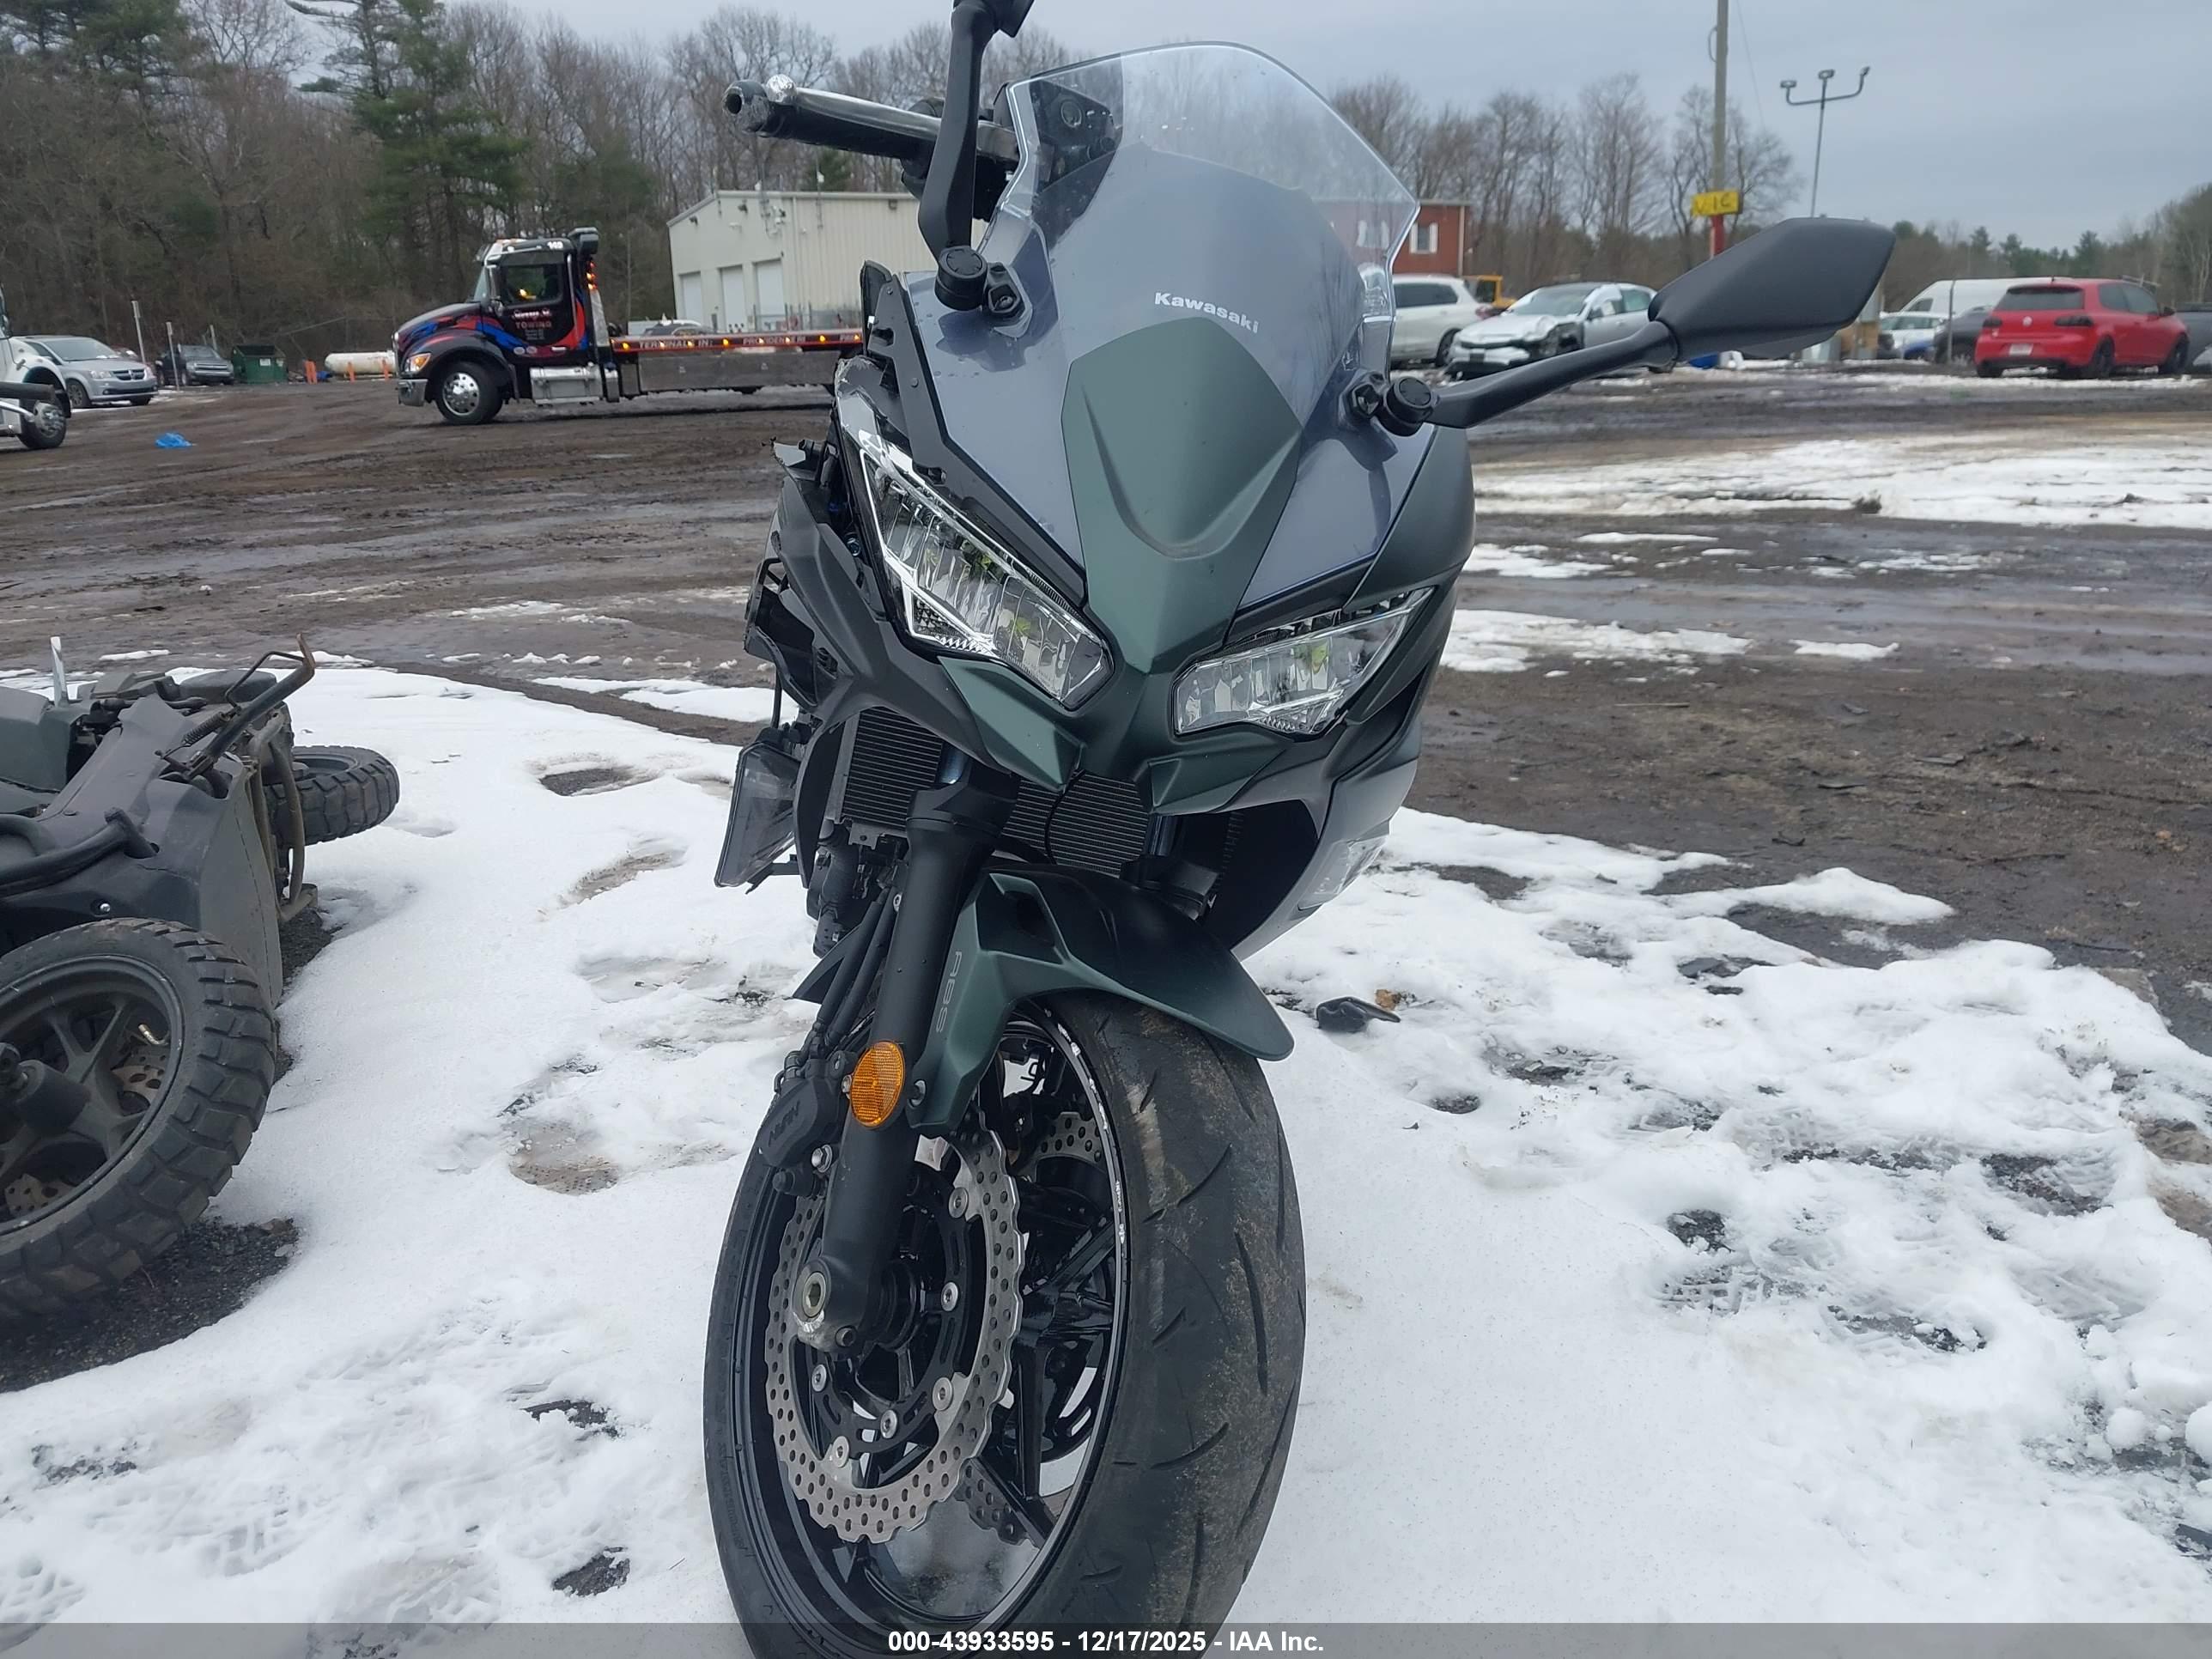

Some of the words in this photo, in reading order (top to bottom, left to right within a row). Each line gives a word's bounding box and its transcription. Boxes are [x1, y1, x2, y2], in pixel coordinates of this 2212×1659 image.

[515, 321, 552, 330] TOWING
[1154, 291, 1260, 334] Kawasaki
[935, 951, 963, 1033] ABS
